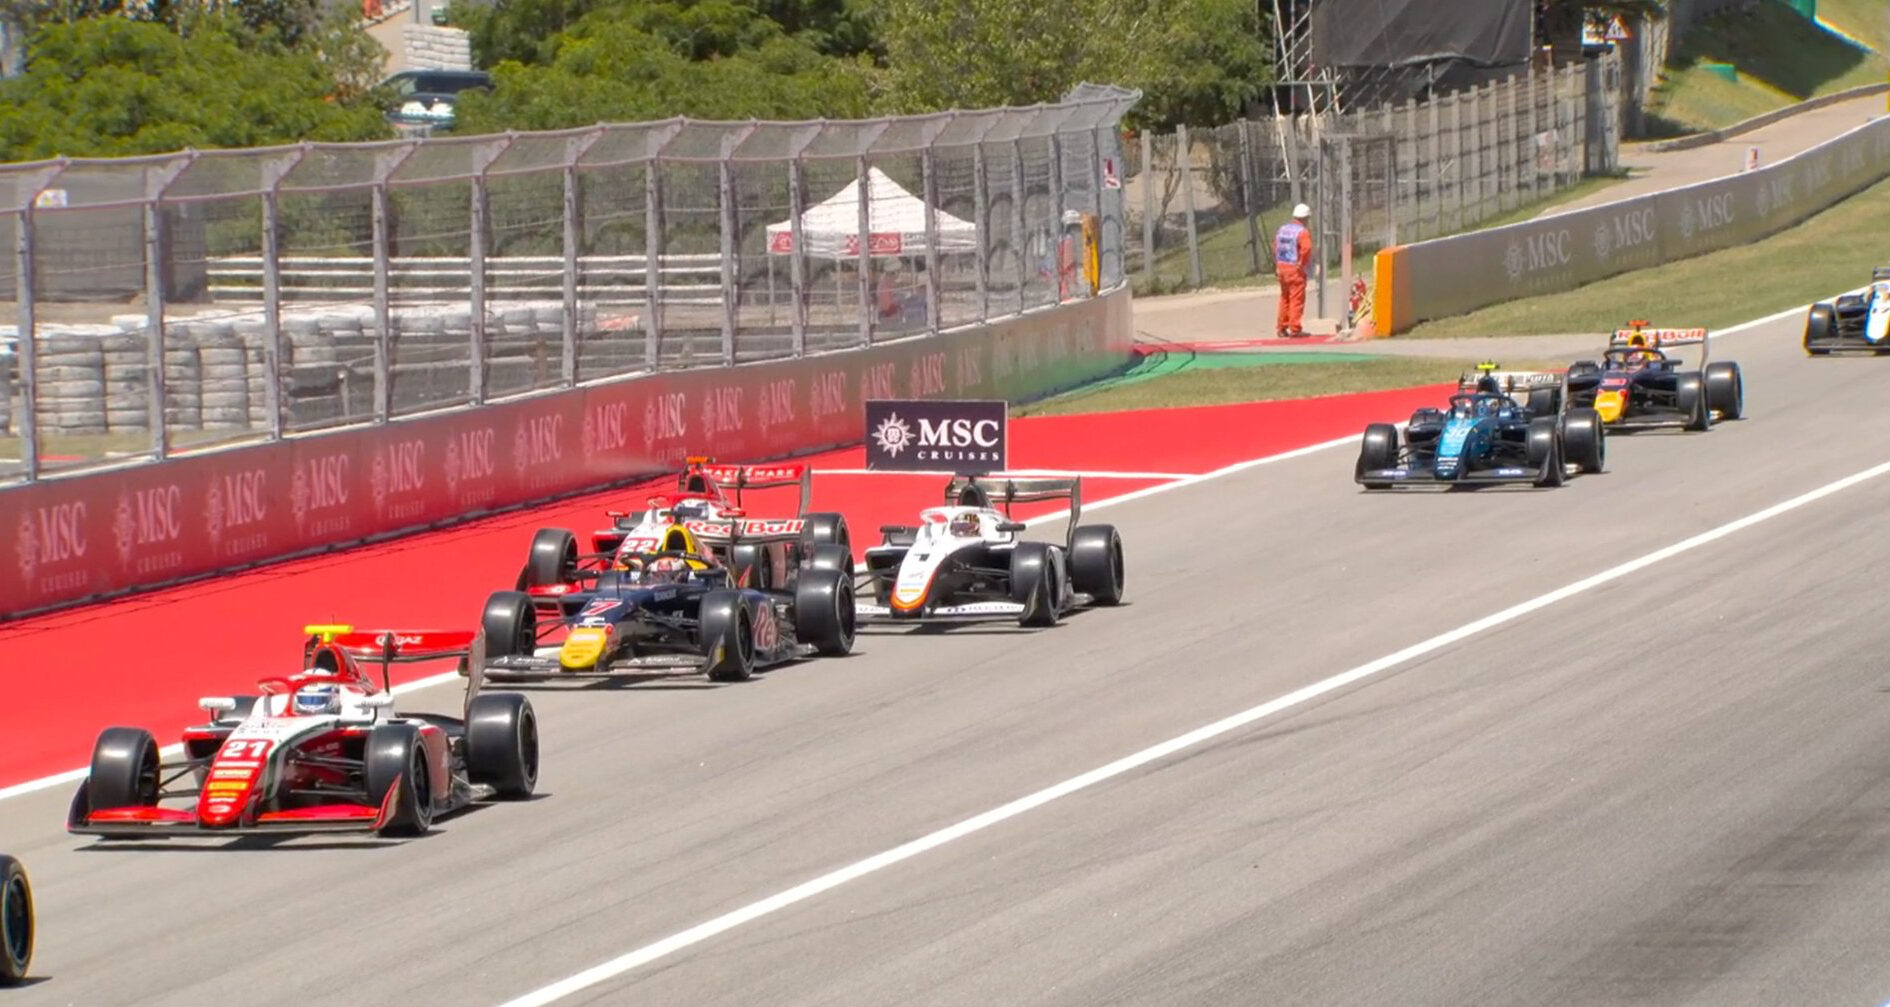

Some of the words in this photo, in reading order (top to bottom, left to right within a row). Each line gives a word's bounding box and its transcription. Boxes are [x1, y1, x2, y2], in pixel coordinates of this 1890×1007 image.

[1613, 208, 1656, 249] MSC
[1697, 192, 1735, 229] MSC
[1526, 229, 1572, 271] MSC
[596, 402, 628, 451] MSC
[657, 392, 687, 440] MSC
[715, 386, 744, 432] MSC
[461, 427, 495, 480] MSC
[530, 414, 564, 464] MSC
[917, 419, 1000, 447] MSC
[389, 439, 425, 493] MSC
[917, 451, 1000, 462] CRUISES
[224, 468, 267, 528] MSC
[310, 453, 350, 510] MSC
[38, 501, 88, 564] MSC
[136, 484, 182, 545] MSC
[745, 519, 804, 535] Bull
[621, 539, 656, 553] 22
[581, 598, 623, 616] 7
[221, 740, 268, 758] 21
